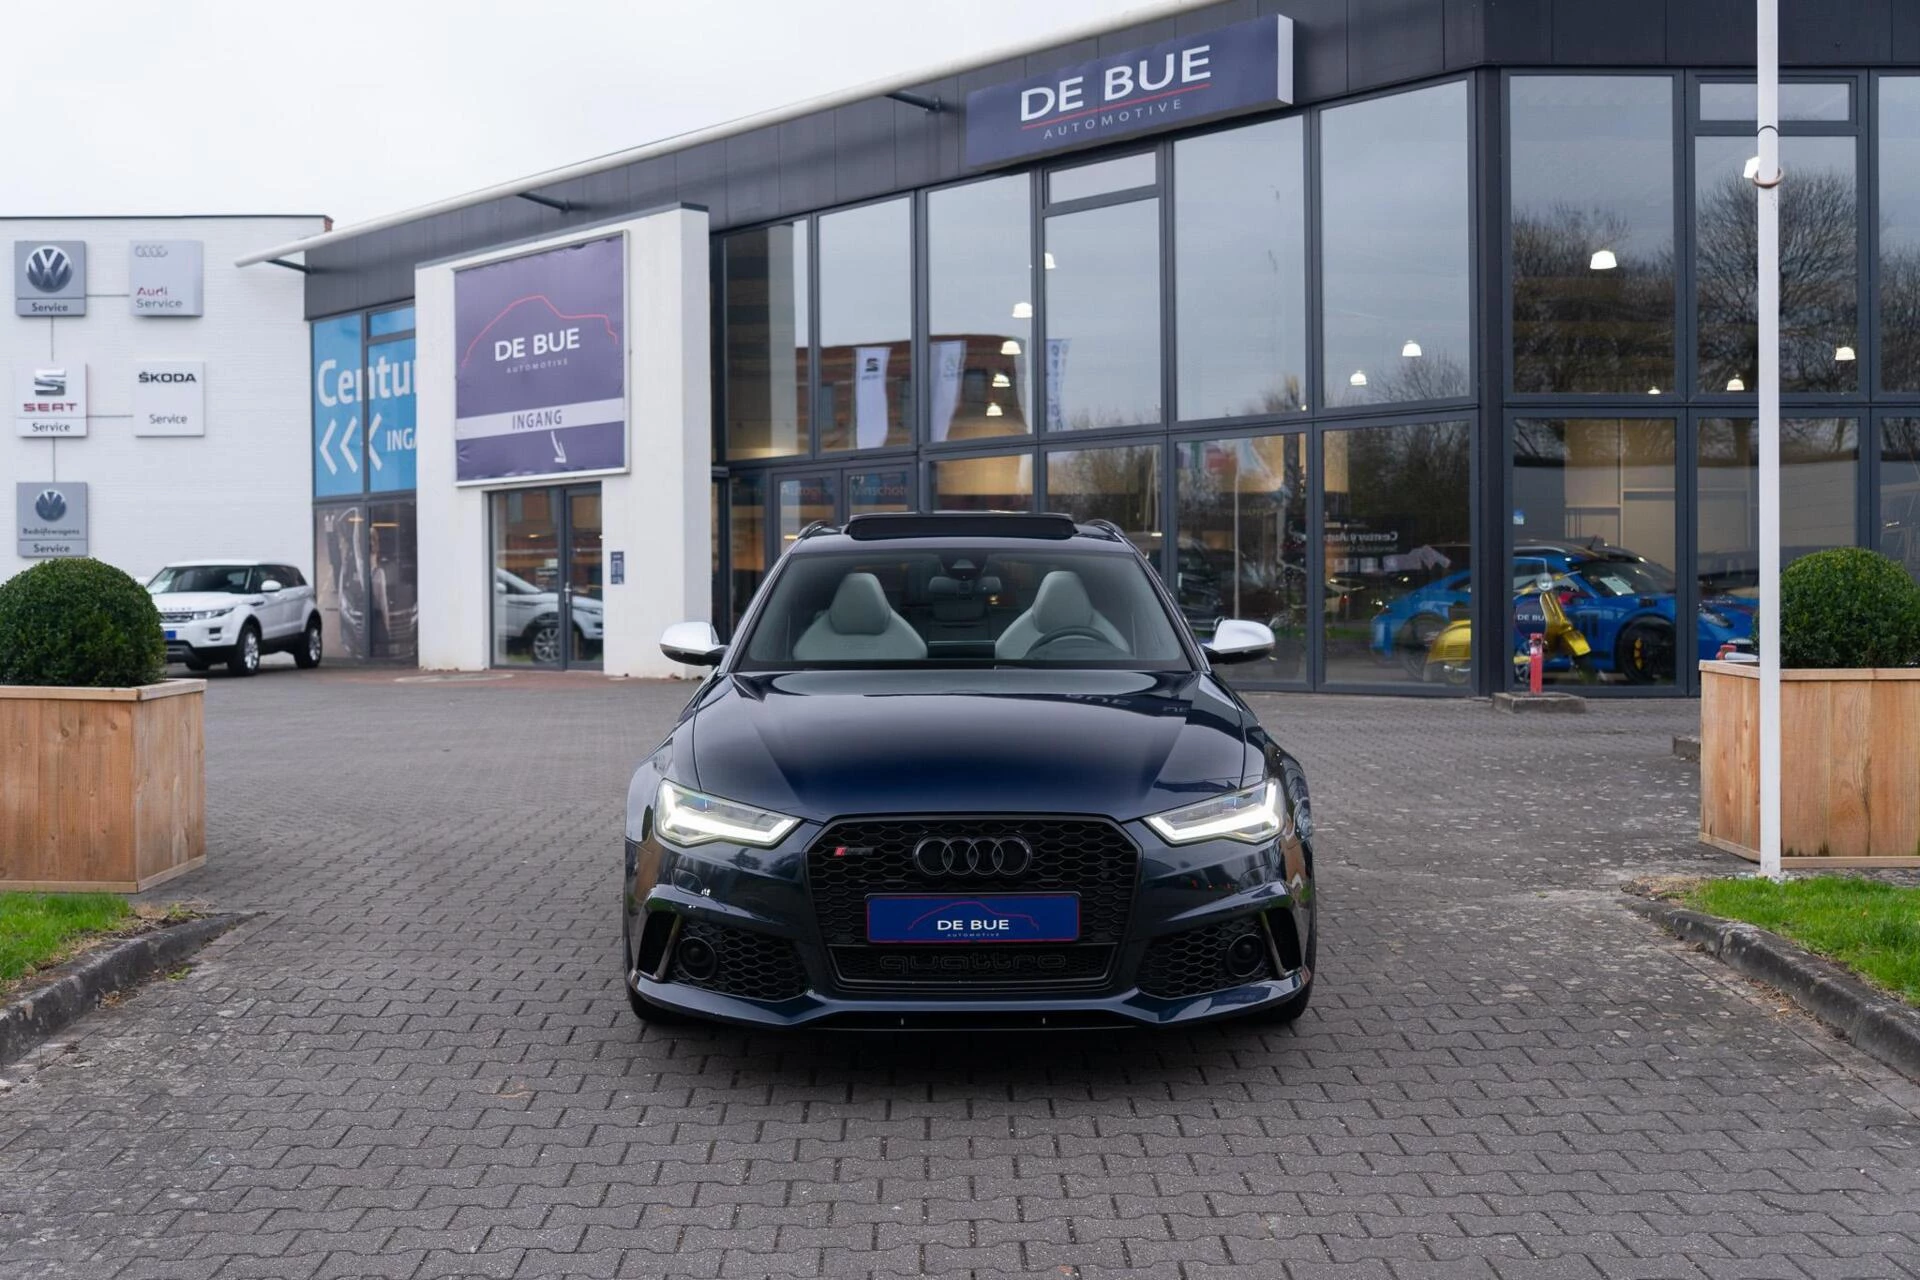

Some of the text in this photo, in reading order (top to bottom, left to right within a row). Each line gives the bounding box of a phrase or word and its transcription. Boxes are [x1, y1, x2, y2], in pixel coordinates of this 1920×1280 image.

[1020, 45, 1212, 121] DE BUE
[1043, 99, 1182, 140] AUTOMOTIVE
[137, 286, 168, 296] Audi
[31, 302, 69, 312] Service
[136, 298, 183, 309] Service
[495, 328, 580, 361] DE BUE
[506, 358, 568, 374] AUTOMOTIVE
[138, 371, 197, 383] ŠKODA
[23, 403, 77, 412] SEAT
[149, 413, 188, 424] Service
[512, 409, 563, 430] INGANG
[32, 422, 71, 432] Service
[33, 543, 71, 553] Service
[937, 919, 1010, 931] DE BUE
[879, 954, 1067, 974] quattro
